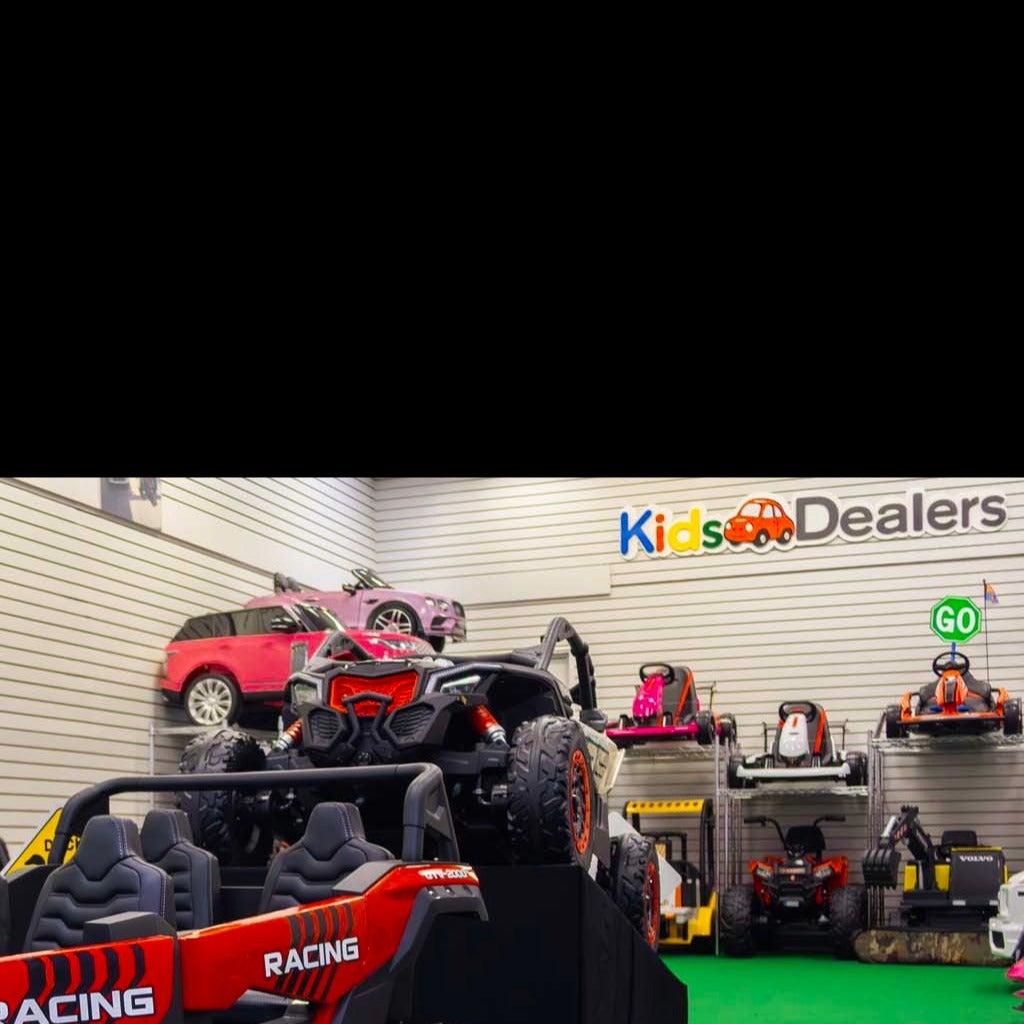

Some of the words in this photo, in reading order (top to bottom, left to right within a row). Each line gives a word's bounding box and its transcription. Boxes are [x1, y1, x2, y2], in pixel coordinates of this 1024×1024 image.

[619, 507, 723, 556] Kids
[796, 493, 1007, 542] Dealers
[936, 605, 976, 634] GO
[263, 936, 360, 978] RACING
